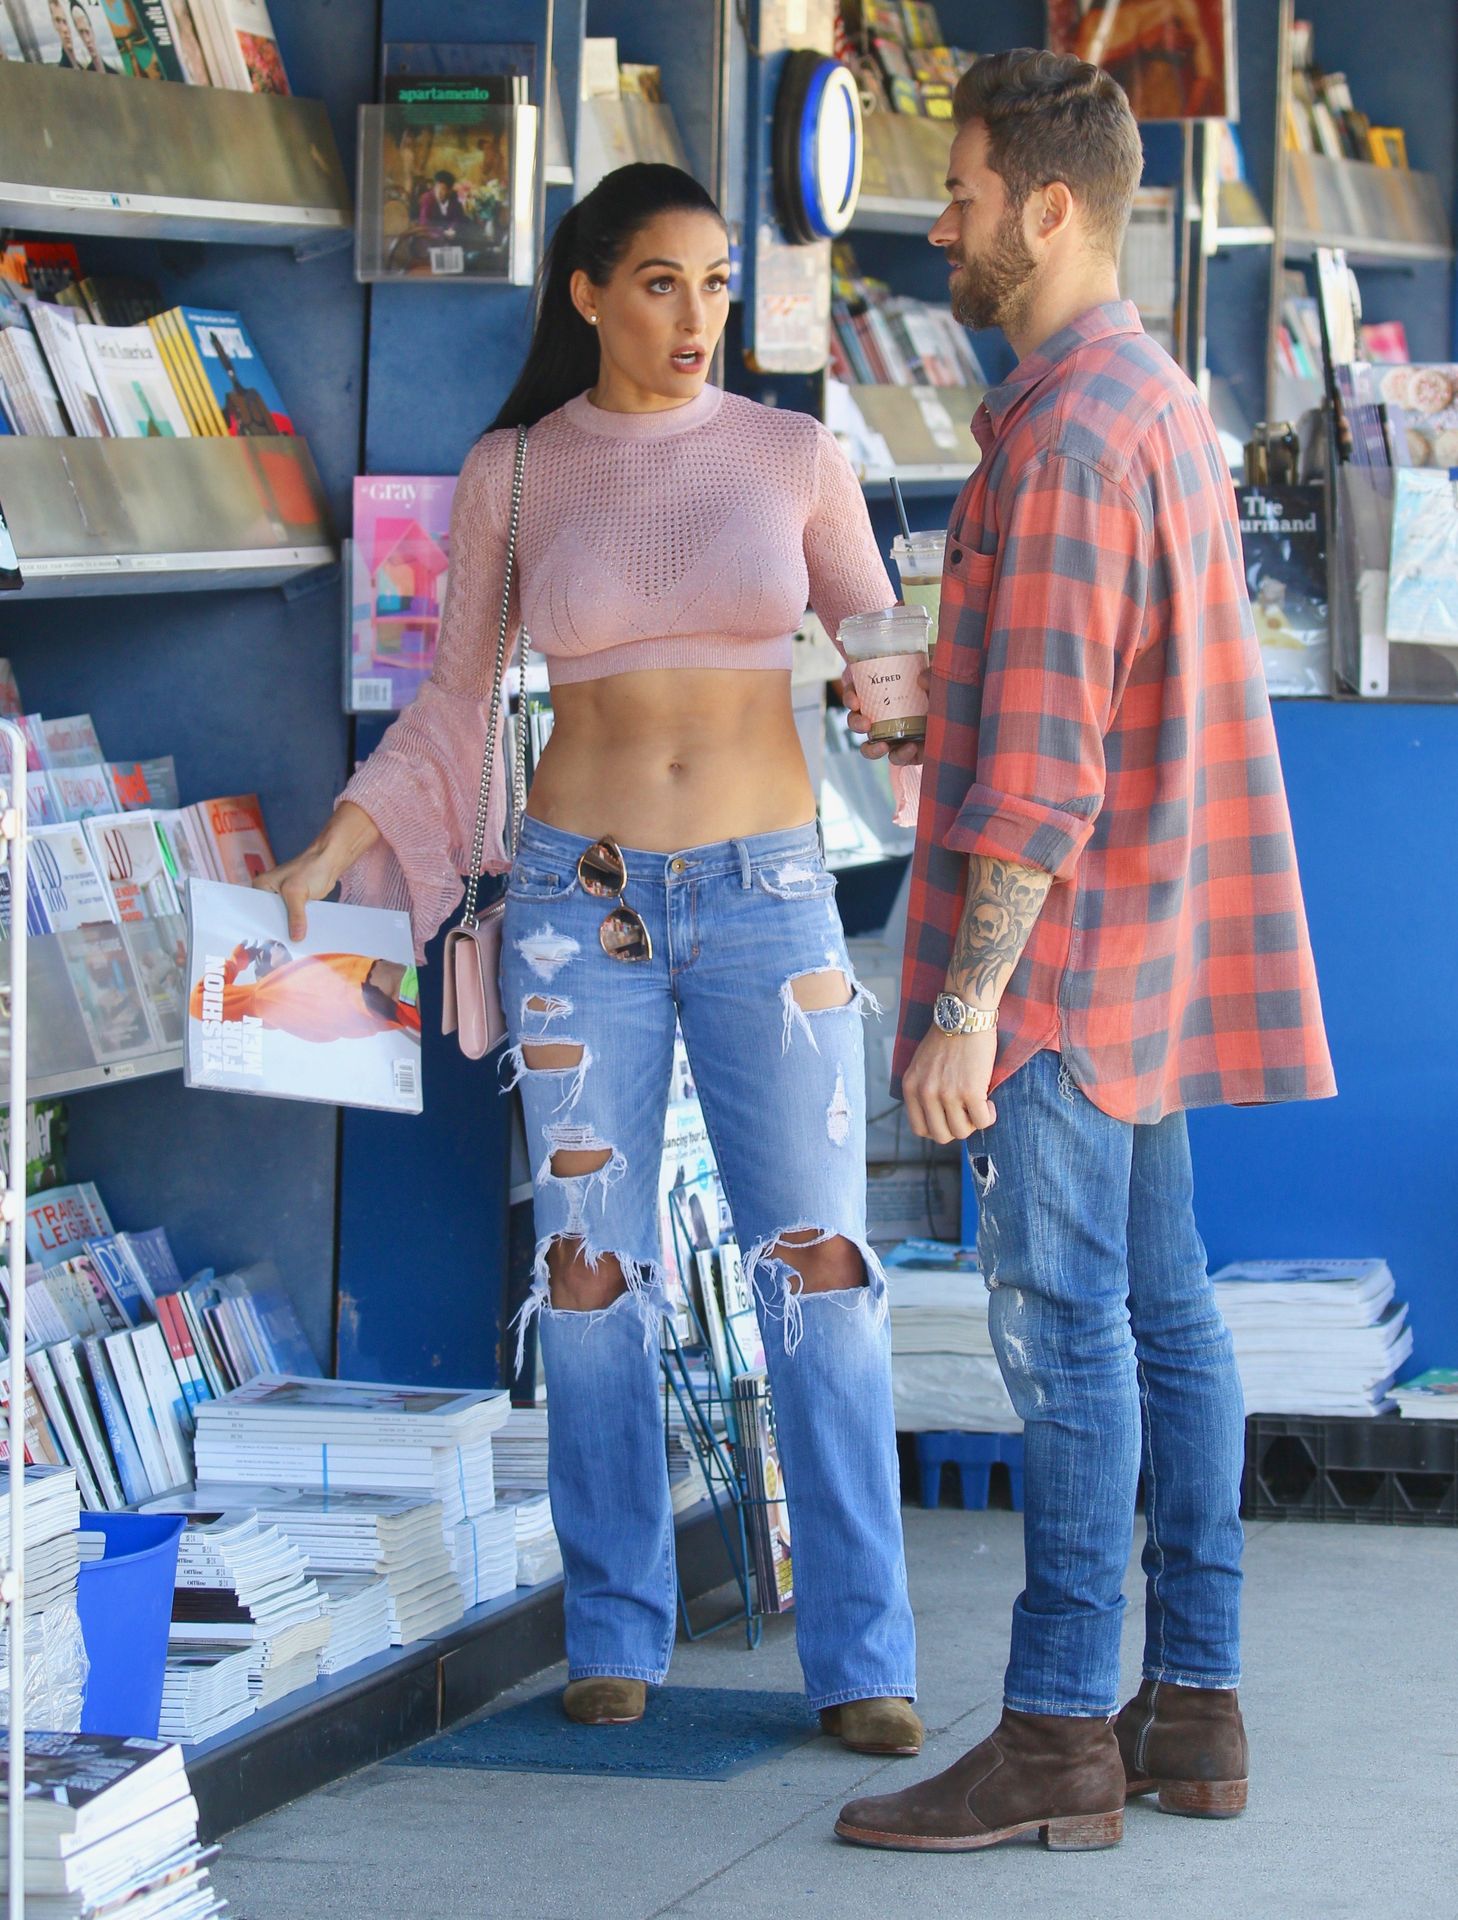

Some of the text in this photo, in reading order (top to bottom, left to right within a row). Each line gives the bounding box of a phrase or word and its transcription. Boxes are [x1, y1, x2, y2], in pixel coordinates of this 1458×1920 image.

[398, 87, 490, 103] apartamento
[1243, 496, 1283, 517] The
[1241, 512, 1316, 532] urmand
[868, 673, 902, 685] ALFRED
[202, 954, 227, 1073] FASHION
[222, 1020, 244, 1073] FOR
[243, 1015, 264, 1076] MEN
